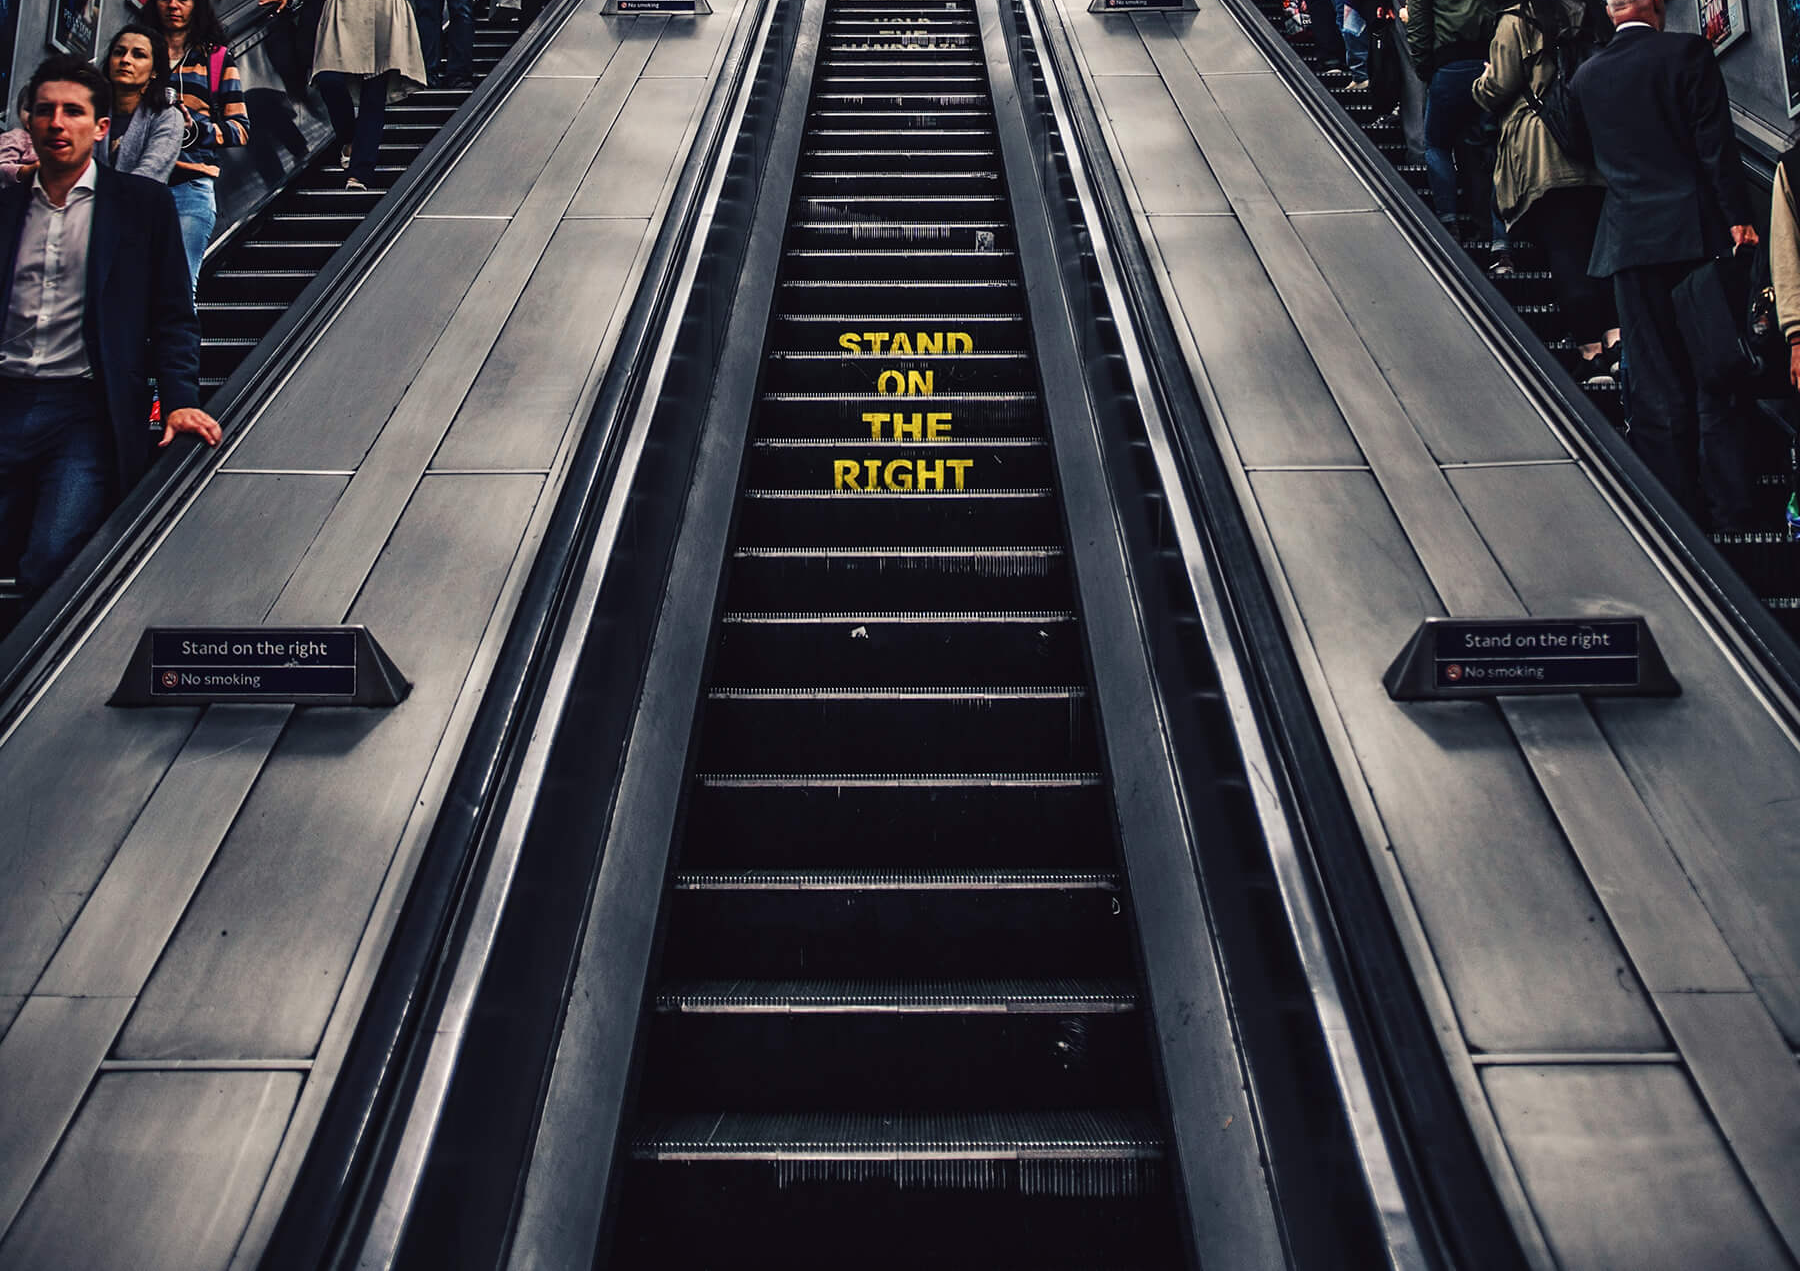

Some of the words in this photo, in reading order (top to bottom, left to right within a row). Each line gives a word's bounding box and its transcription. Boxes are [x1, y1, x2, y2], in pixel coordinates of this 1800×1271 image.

[839, 332, 974, 354] STAND
[877, 370, 934, 395] ON
[862, 412, 952, 441] THE
[833, 459, 974, 491] RIGHT
[182, 640, 229, 656] Stand
[232, 644, 253, 655] on
[256, 640, 285, 655] the
[288, 640, 328, 659] right
[1465, 633, 1512, 648] Stand
[1516, 636, 1536, 647] on
[1540, 633, 1568, 647] the
[1571, 633, 1611, 650] right
[181, 673, 201, 686] No
[204, 673, 261, 689] smoking
[1465, 666, 1485, 678] No
[1487, 665, 1545, 679] smoking
